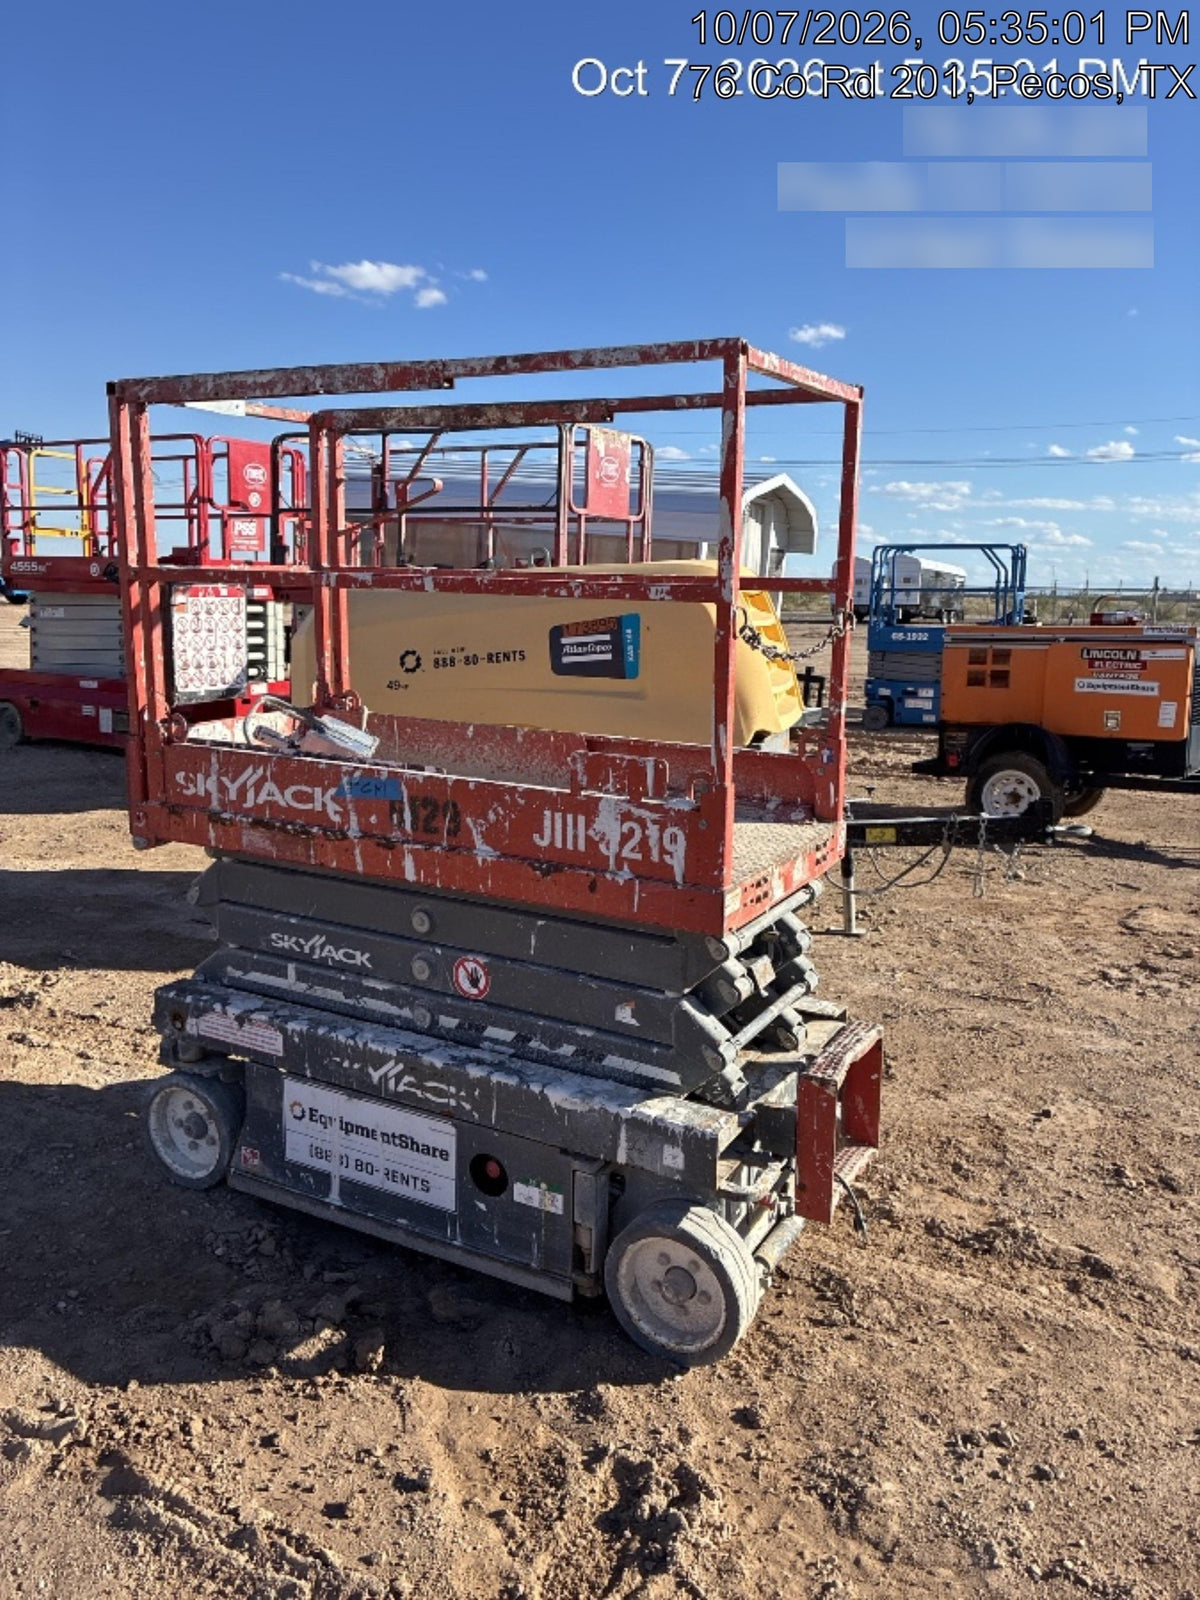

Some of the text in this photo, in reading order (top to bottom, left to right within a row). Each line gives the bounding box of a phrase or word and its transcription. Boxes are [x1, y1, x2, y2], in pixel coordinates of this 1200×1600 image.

[1082, 648, 1137, 660] LINCOLN
[175, 765, 343, 814] SKYJACK
[271, 932, 372, 968] SKYJACK
[355, 1158, 431, 1193] 80-RENTS
